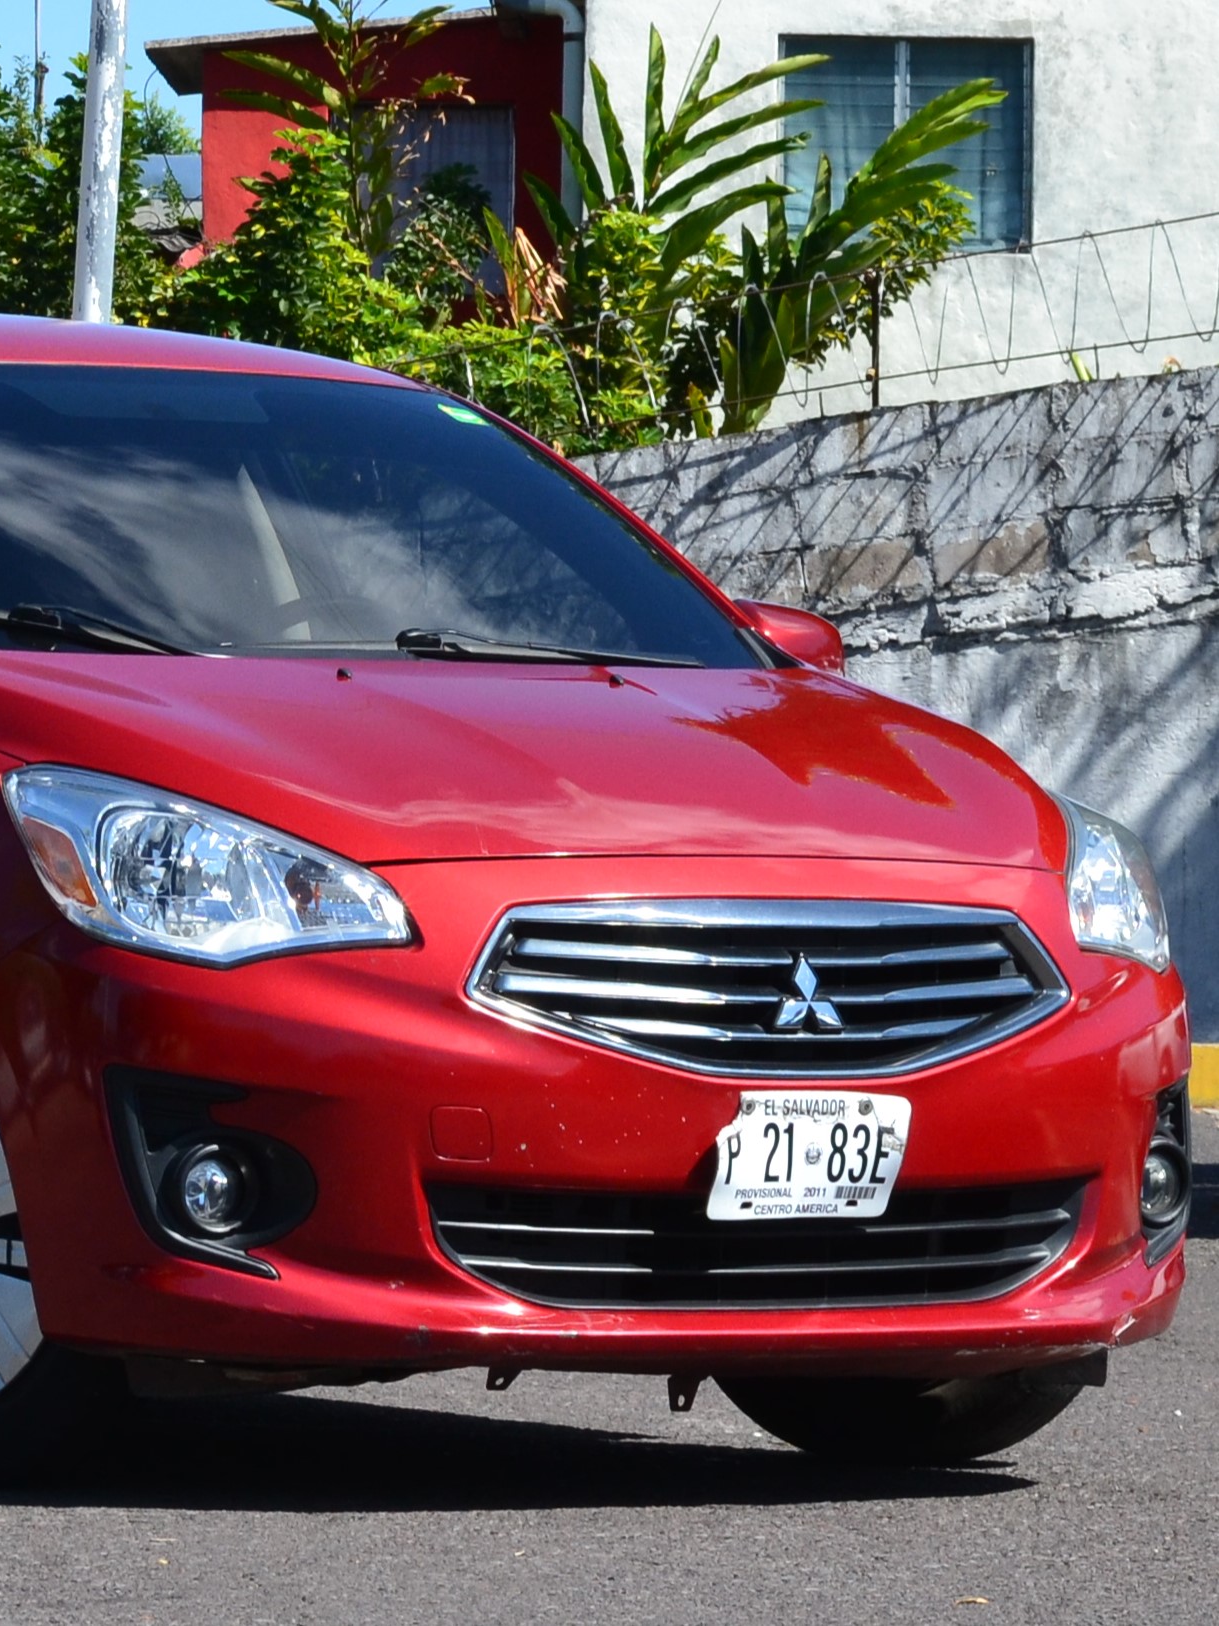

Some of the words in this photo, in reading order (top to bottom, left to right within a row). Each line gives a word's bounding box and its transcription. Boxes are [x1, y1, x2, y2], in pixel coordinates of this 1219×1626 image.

[763, 1099, 779, 1116] EL
[782, 1099, 846, 1117] SALVADOR
[763, 1122, 794, 1183] 21
[734, 1188, 793, 1199] PROVISIONAL
[803, 1187, 827, 1198] 2011
[753, 1204, 793, 1216] CENTRO
[794, 1203, 839, 1215] AMERICA
